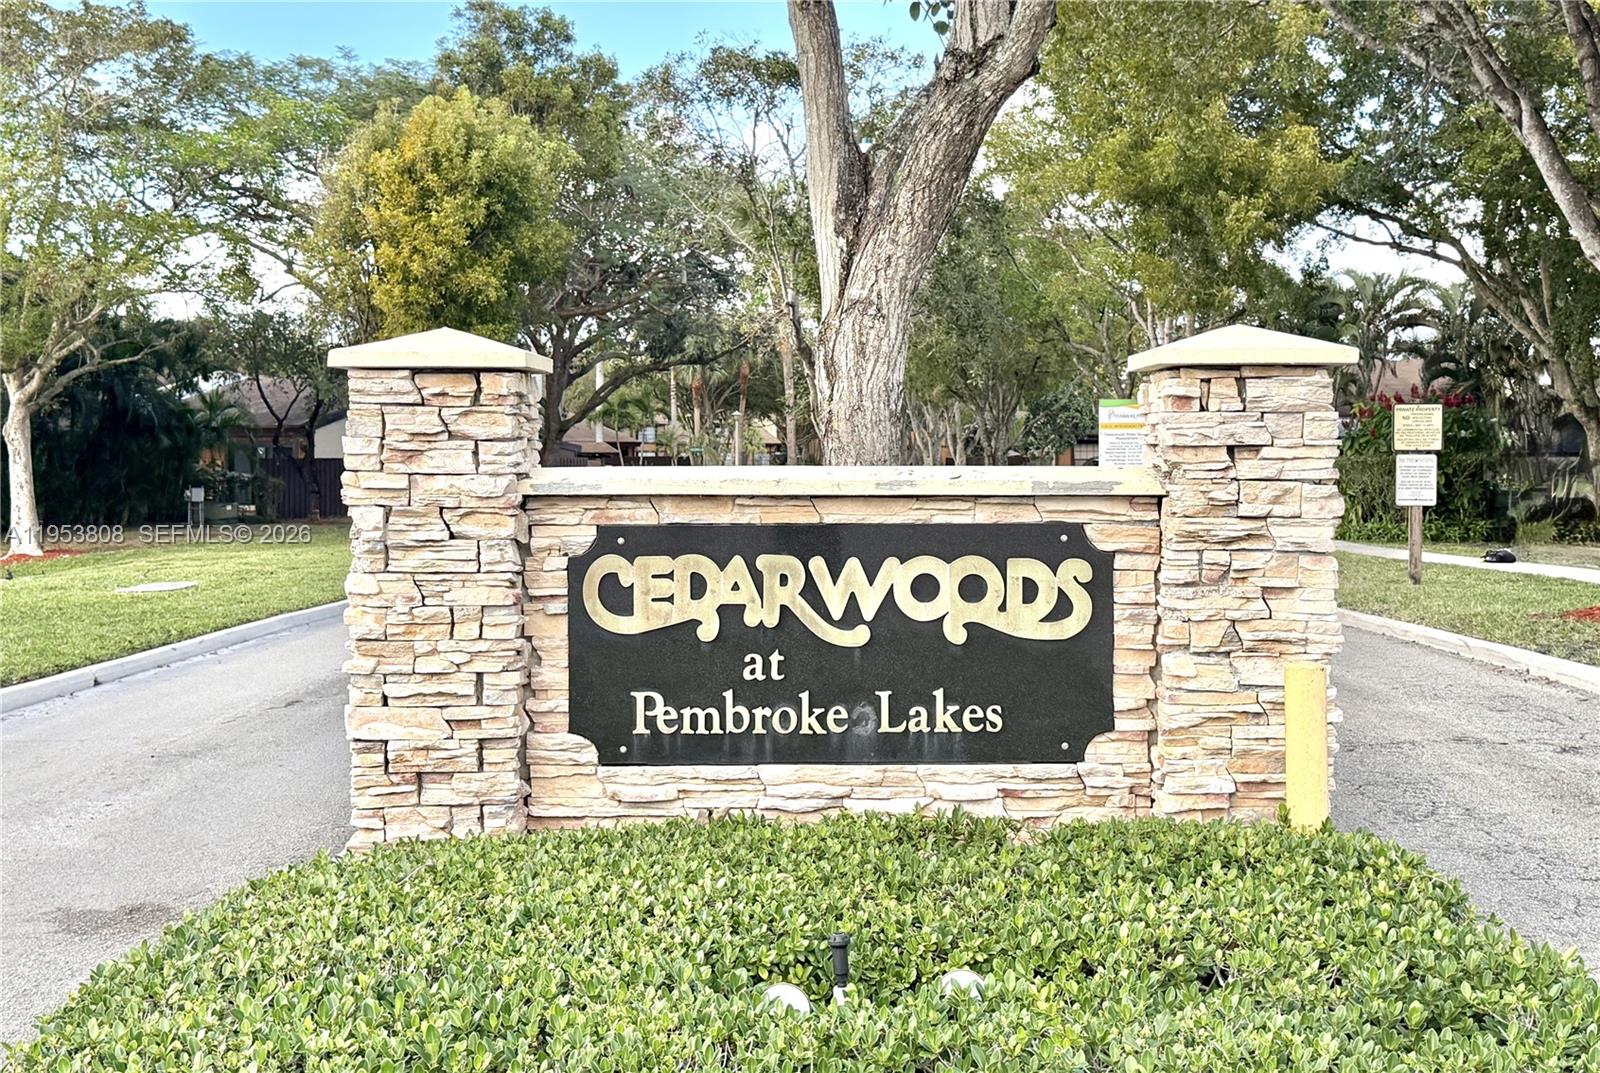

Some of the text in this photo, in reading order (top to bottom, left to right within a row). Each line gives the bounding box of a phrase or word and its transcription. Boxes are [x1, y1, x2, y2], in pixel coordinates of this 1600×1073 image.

[582, 553, 1094, 648] CEDARWOODS
[742, 648, 785, 681] at
[630, 687, 1003, 735] Pembroke Lakes
